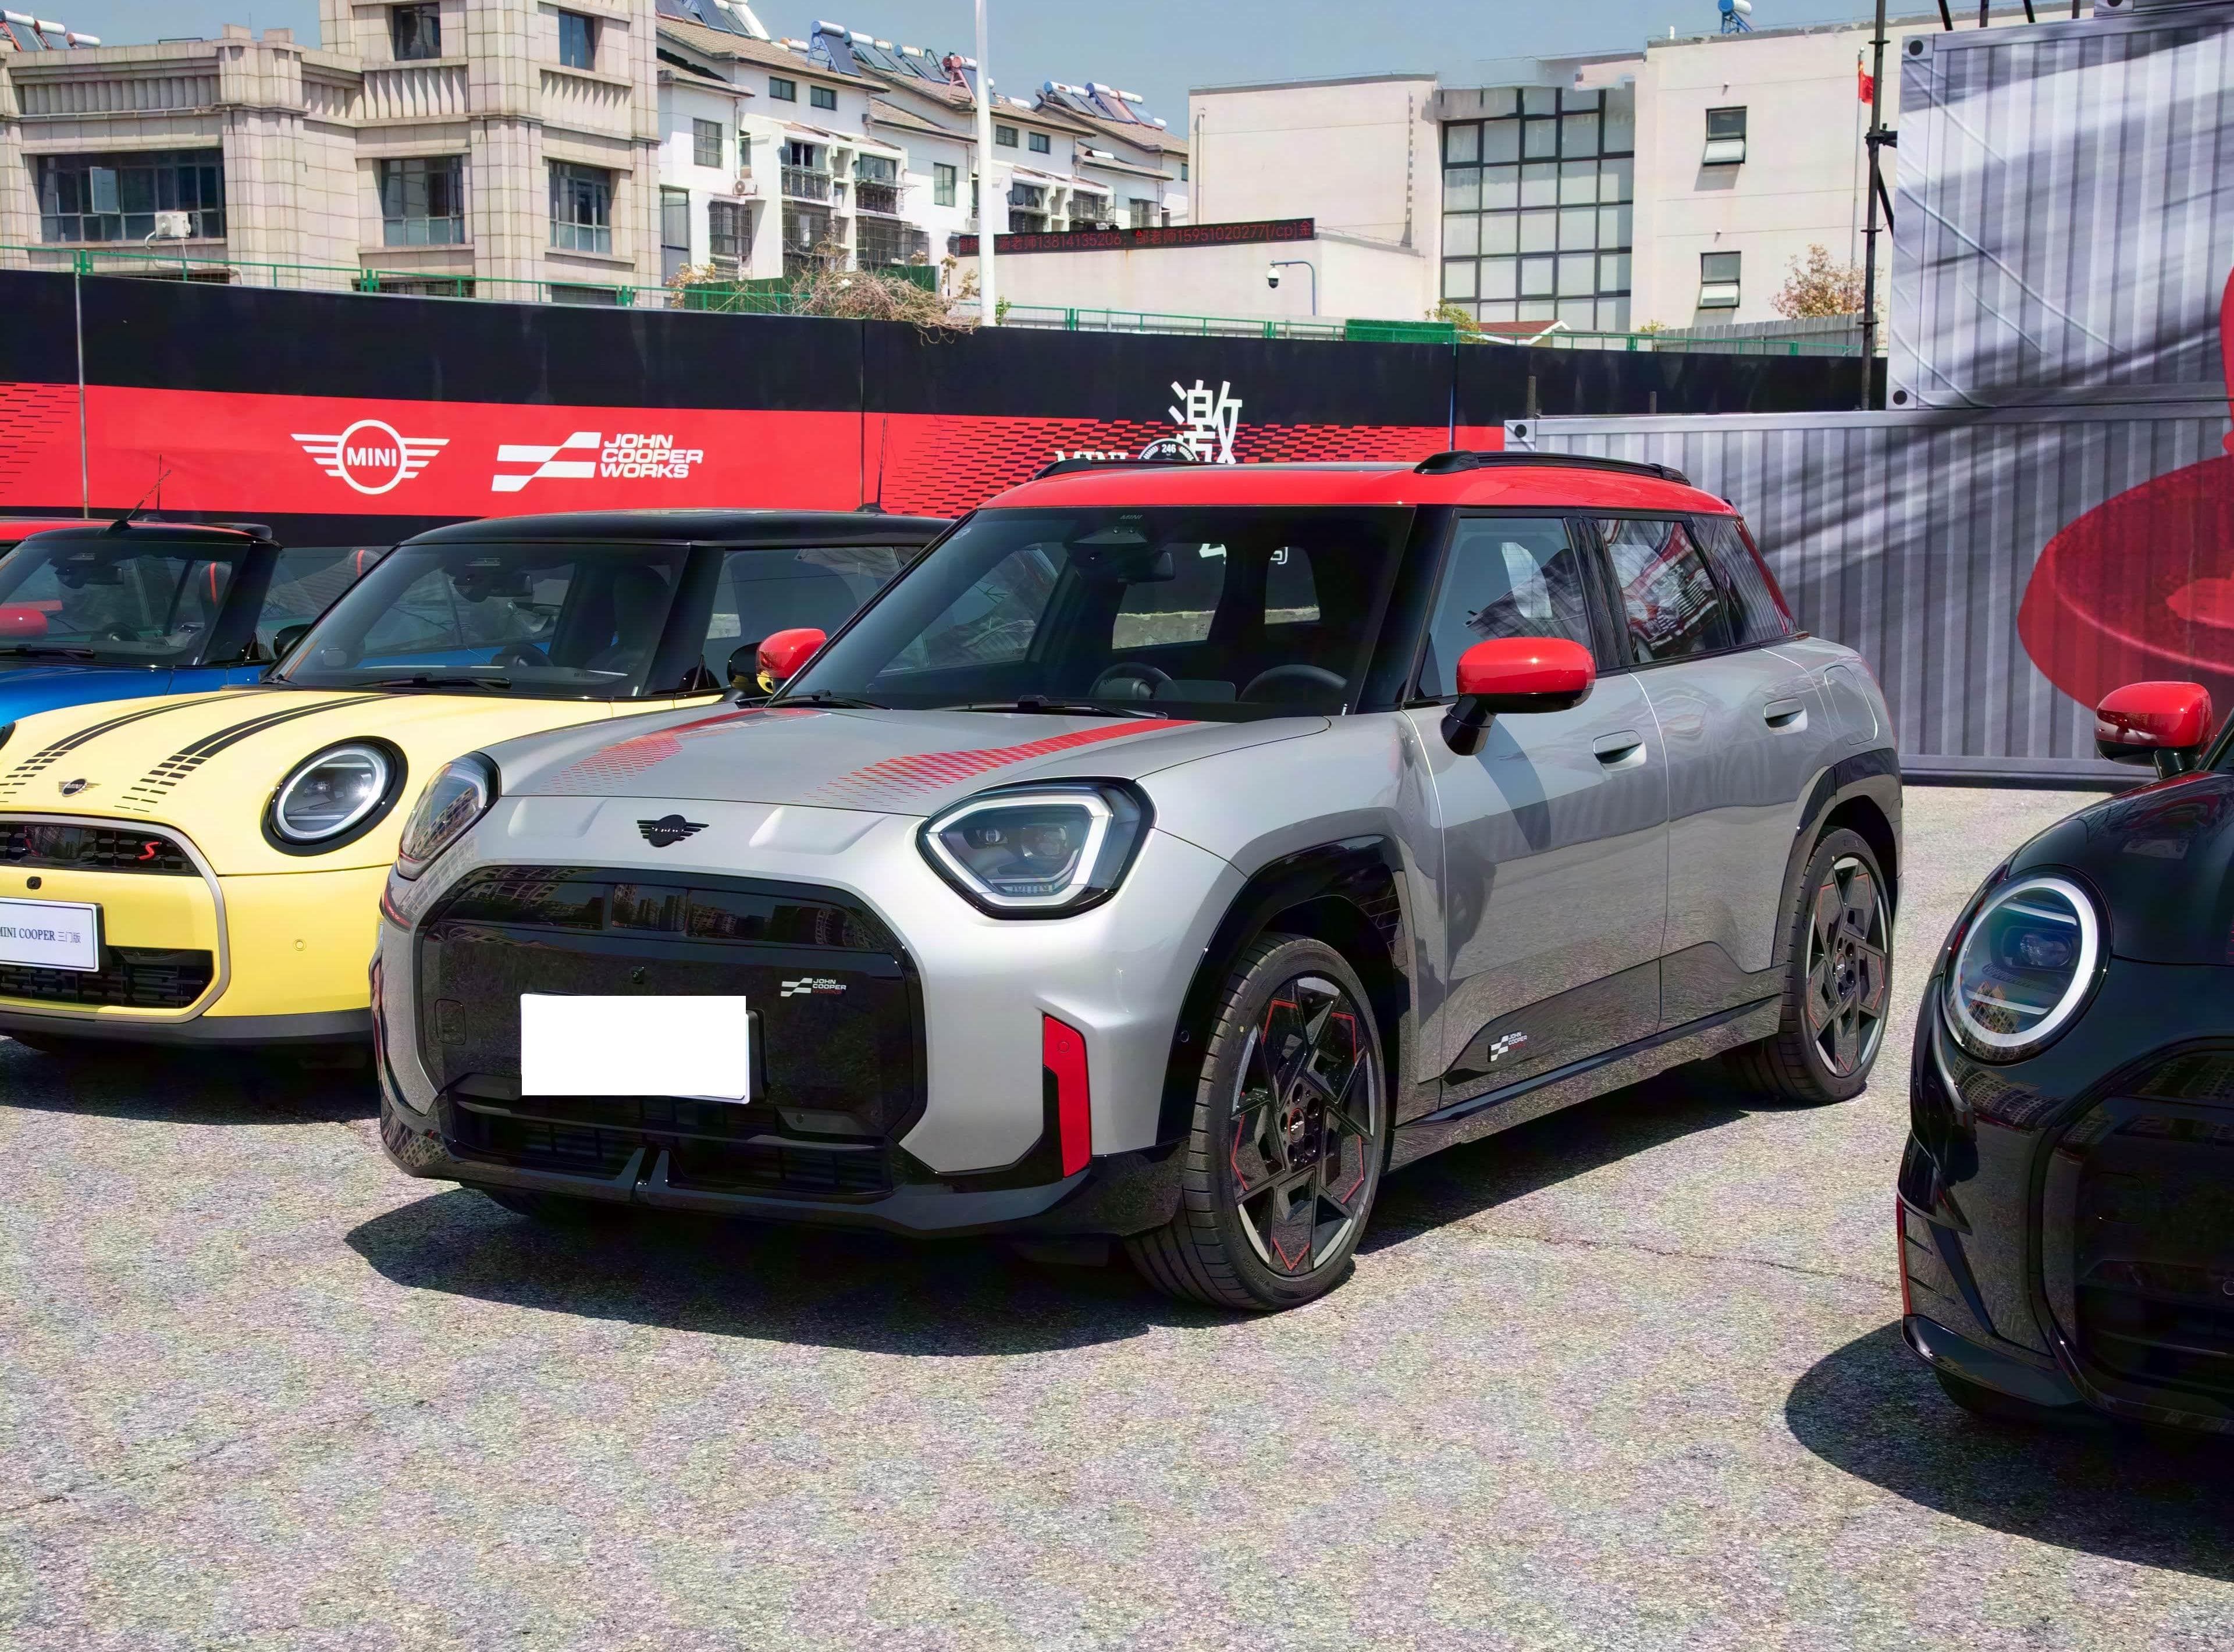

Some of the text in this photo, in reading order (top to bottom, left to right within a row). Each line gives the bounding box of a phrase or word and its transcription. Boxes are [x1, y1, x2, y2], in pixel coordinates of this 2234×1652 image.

[1168, 379, 1243, 465] 激
[604, 433, 674, 449] JOHN
[1161, 443, 1176, 454] 246
[347, 447, 397, 467] MINI
[601, 448, 704, 464] COOPER
[600, 462, 689, 479] WORKS
[138, 841, 159, 860] S
[19, 928, 56, 941] COOPER
[57, 931, 81, 944] 三门版
[1508, 1031, 1522, 1040] JOHN
